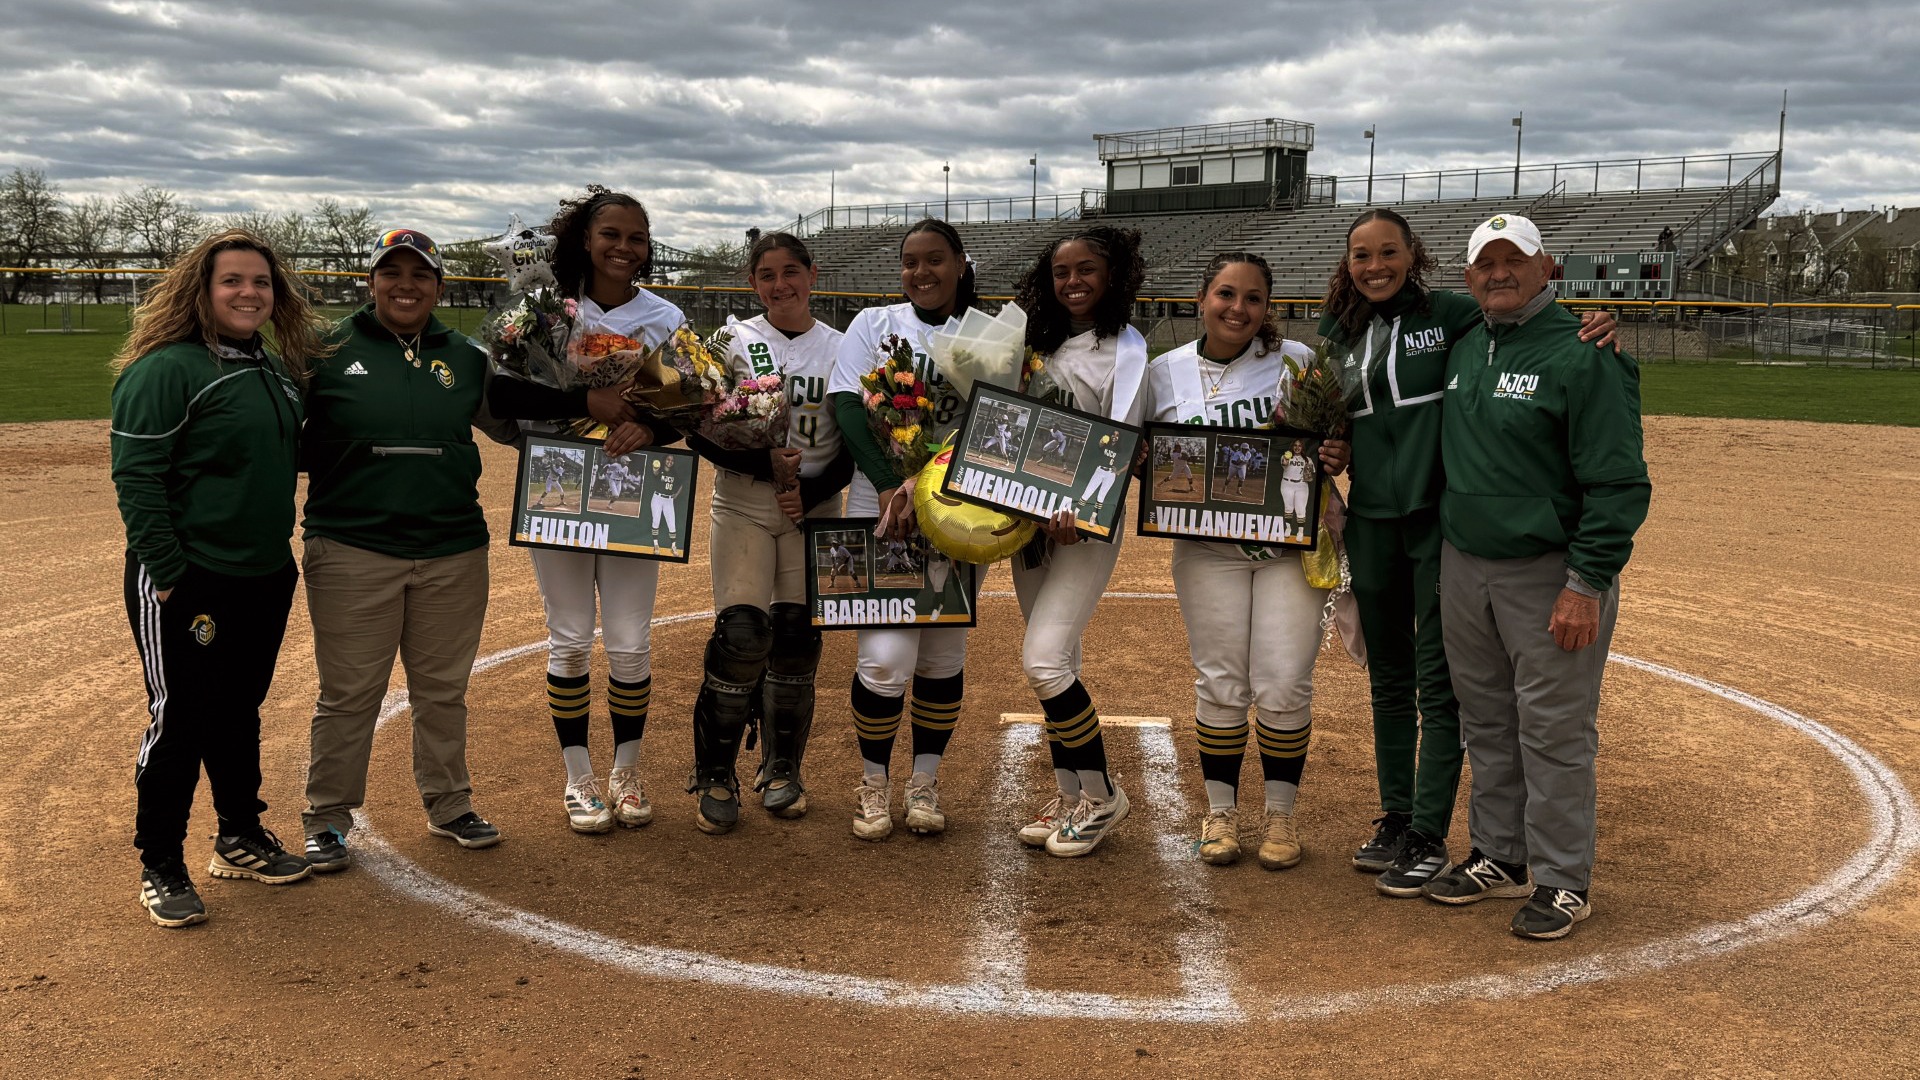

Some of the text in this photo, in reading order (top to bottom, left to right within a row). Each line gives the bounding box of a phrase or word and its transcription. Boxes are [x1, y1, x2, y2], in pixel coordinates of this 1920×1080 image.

[1590, 255, 1615, 264] INNING
[1639, 254, 1665, 263] GUESTS
[1571, 281, 1594, 291] STRIKE
[1611, 281, 1624, 290] OUT
[1403, 326, 1445, 349] NJCU
[748, 342, 775, 378] SEN
[1405, 345, 1448, 357] SOFTBALL
[790, 375, 824, 406] CU
[1492, 391, 1533, 401] SOFTBALL
[1496, 372, 1540, 394] NJCU
[1209, 396, 1273, 428] JCU
[798, 414, 817, 447] 4
[959, 467, 1073, 522] MENDOLLA
[529, 515, 610, 550] FULTON
[1156, 505, 1286, 543] VILLANUEVA
[823, 597, 917, 626] BARRIOS
